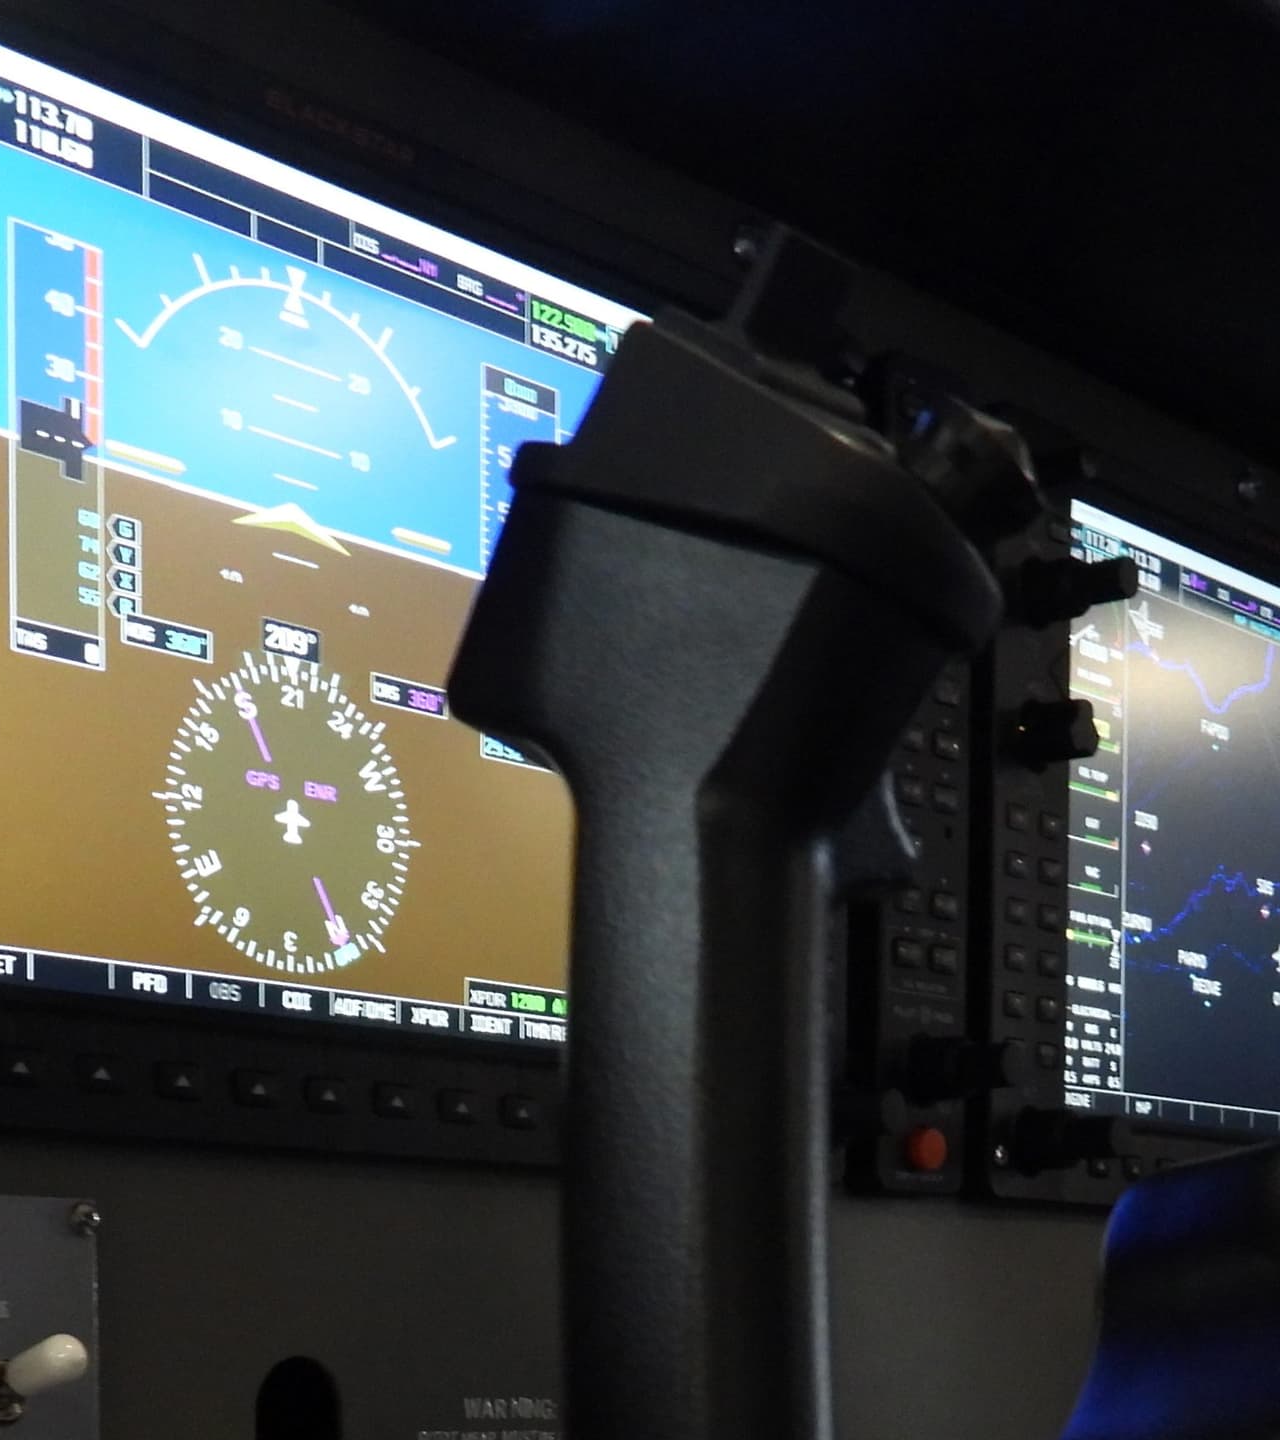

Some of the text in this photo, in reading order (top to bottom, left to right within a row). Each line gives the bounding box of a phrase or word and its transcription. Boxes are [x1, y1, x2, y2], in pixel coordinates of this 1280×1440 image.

[234, 692, 257, 719] S
[281, 685, 304, 709] 21
[327, 711, 354, 740] 24
[245, 769, 281, 791] GPS
[359, 760, 387, 792] W
[181, 783, 202, 810] 12
[376, 824, 396, 854] 30
[194, 849, 222, 878] E
[361, 881, 385, 910] 33
[283, 932, 298, 951] 3
[132, 971, 168, 994] PFD
[209, 981, 242, 1003] OBS
